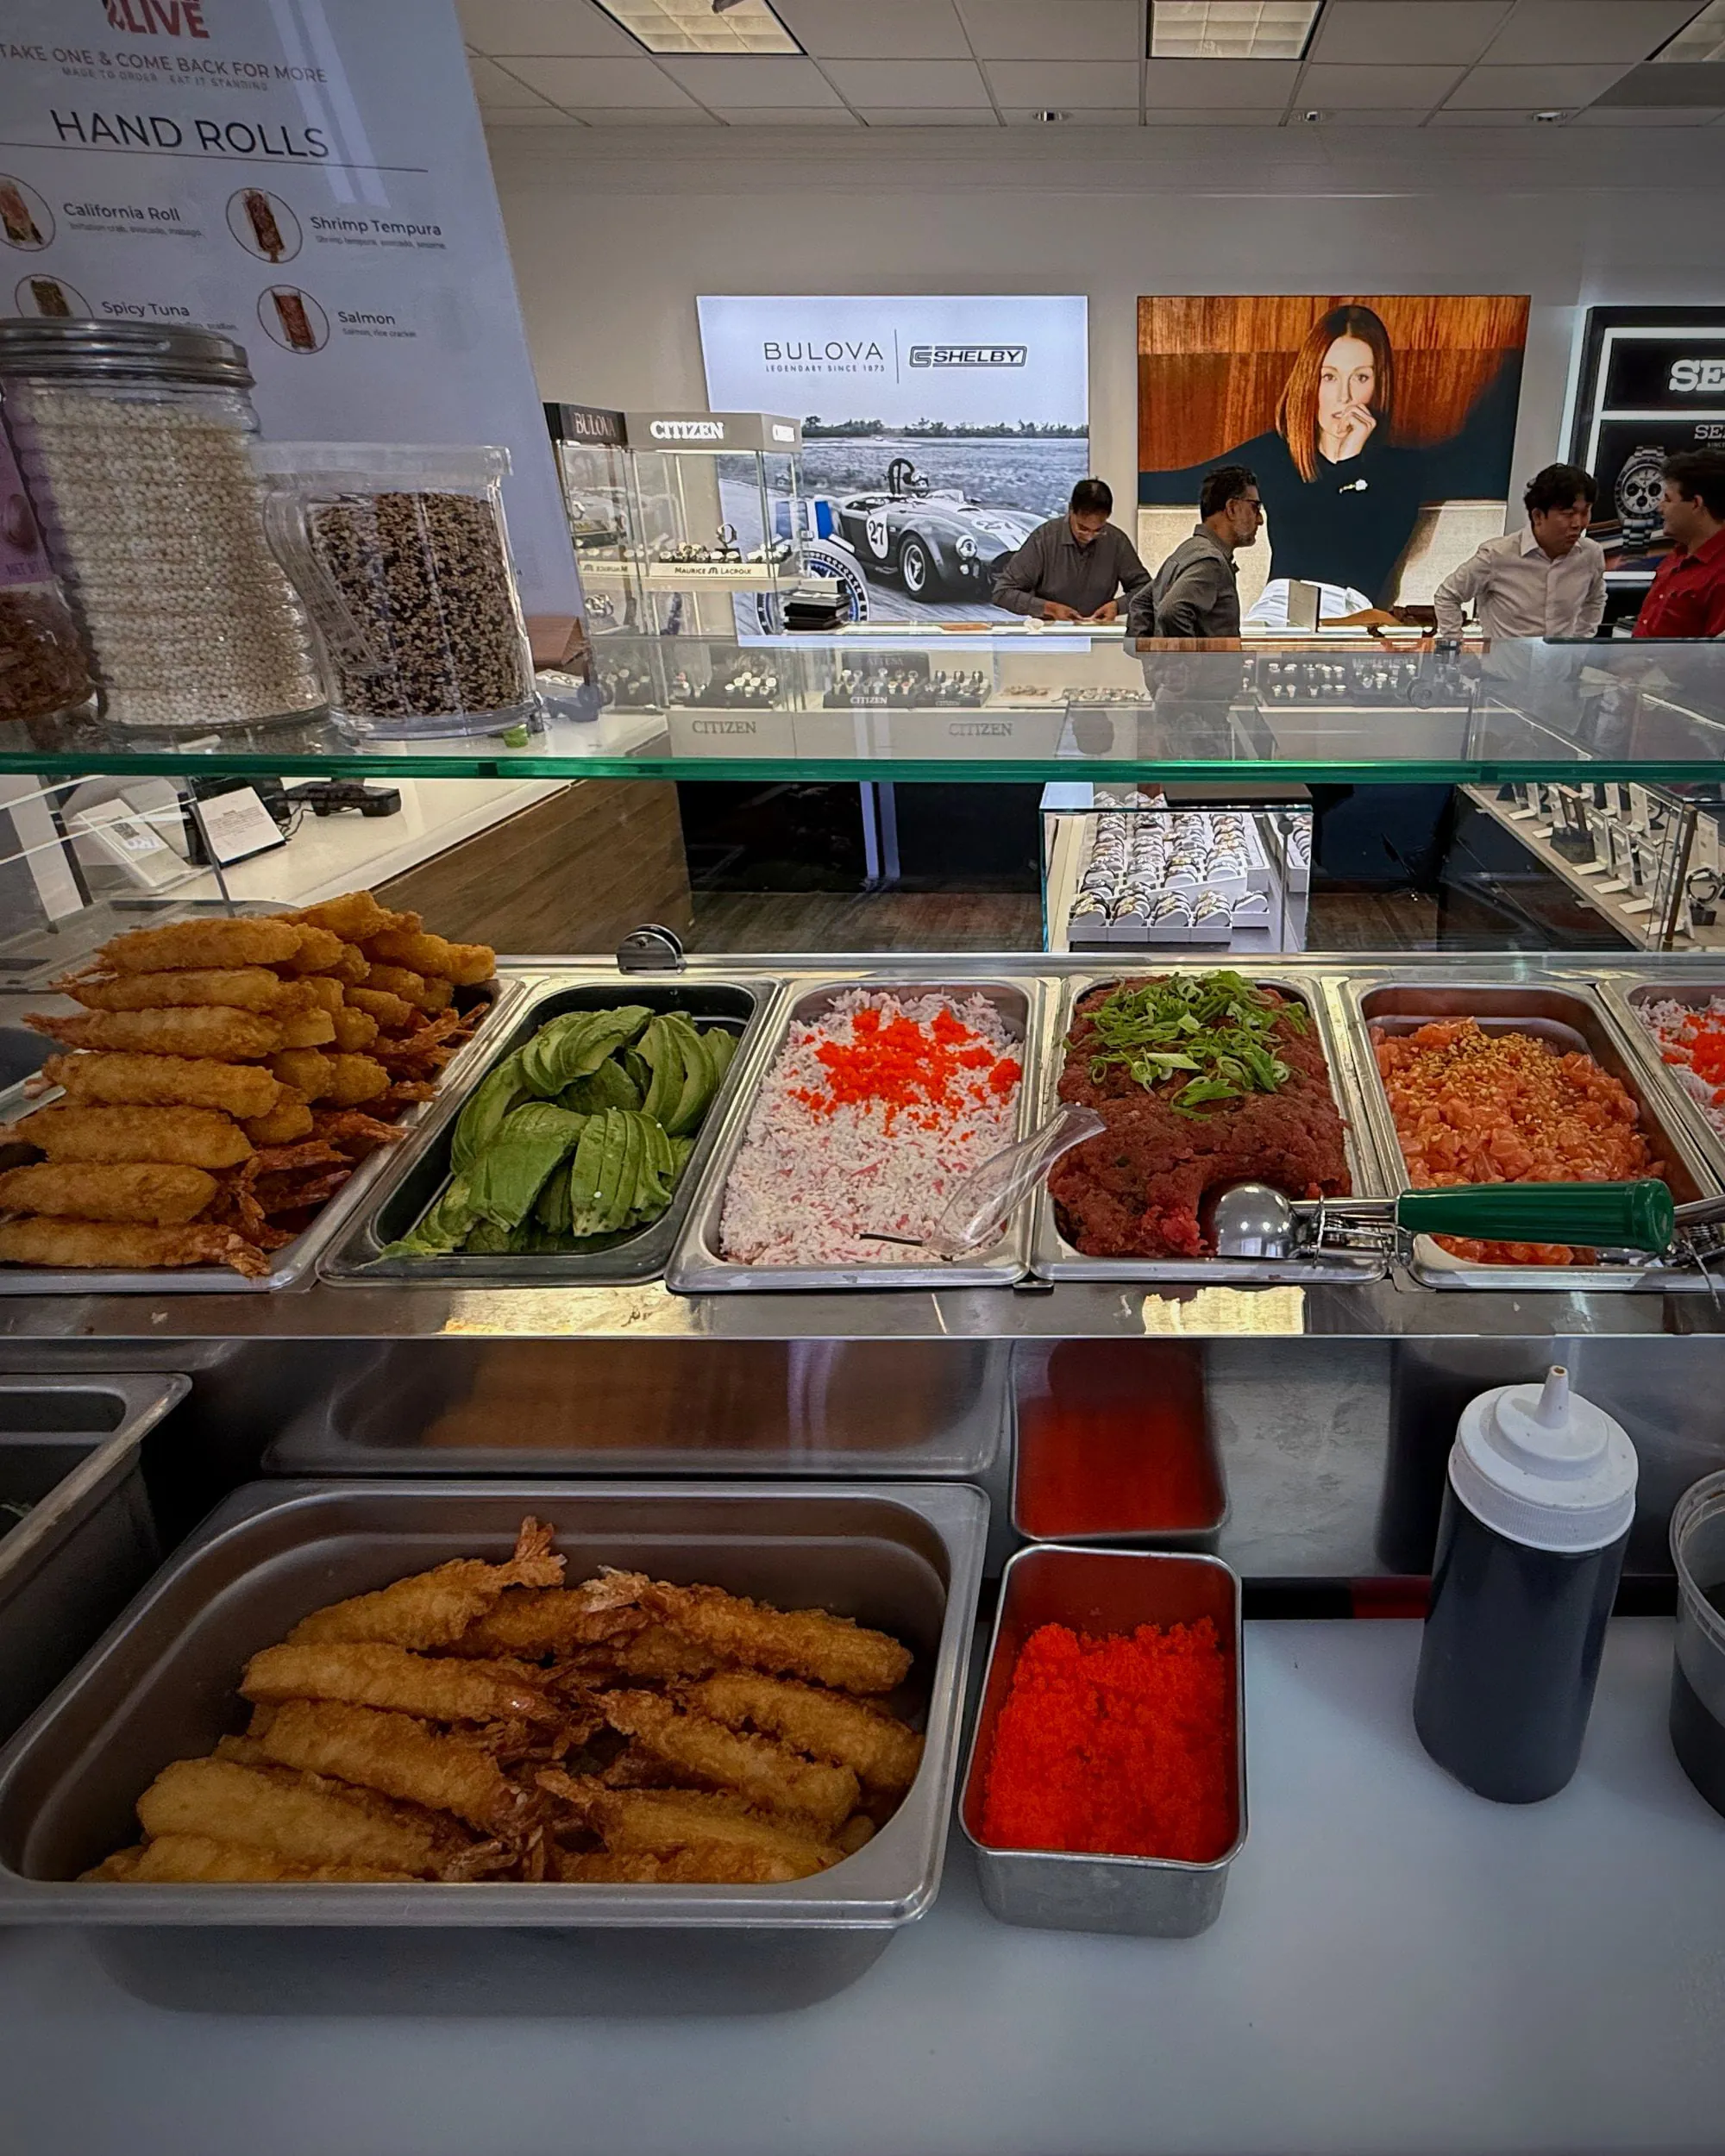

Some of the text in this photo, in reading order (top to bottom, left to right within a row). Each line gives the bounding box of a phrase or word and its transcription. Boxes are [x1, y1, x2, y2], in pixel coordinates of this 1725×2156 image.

[0, 44, 328, 84] TAKE ONE & COME BACK FOR MORE
[101, 70, 116, 79] TO
[119, 71, 158, 83] ORDER
[50, 110, 329, 158] HAND ROLLS
[63, 203, 180, 221] California Roll
[310, 216, 442, 236] Shrimp Tempura
[102, 301, 190, 317] Spicy Tuna
[337, 310, 395, 324] Salmon
[763, 342, 883, 360] BULOVA
[766, 364, 822, 373] LEGENDARY
[827, 364, 856, 373] SINCE
[574, 413, 617, 437] BULOVA
[649, 421, 724, 439] CITIZEN
[1694, 424, 1725, 440] SE
[869, 519, 885, 545] 27
[850, 696, 888, 705] CITIZEN
[693, 720, 756, 734] CITIZEN
[949, 722, 1013, 736] CITIZEN
